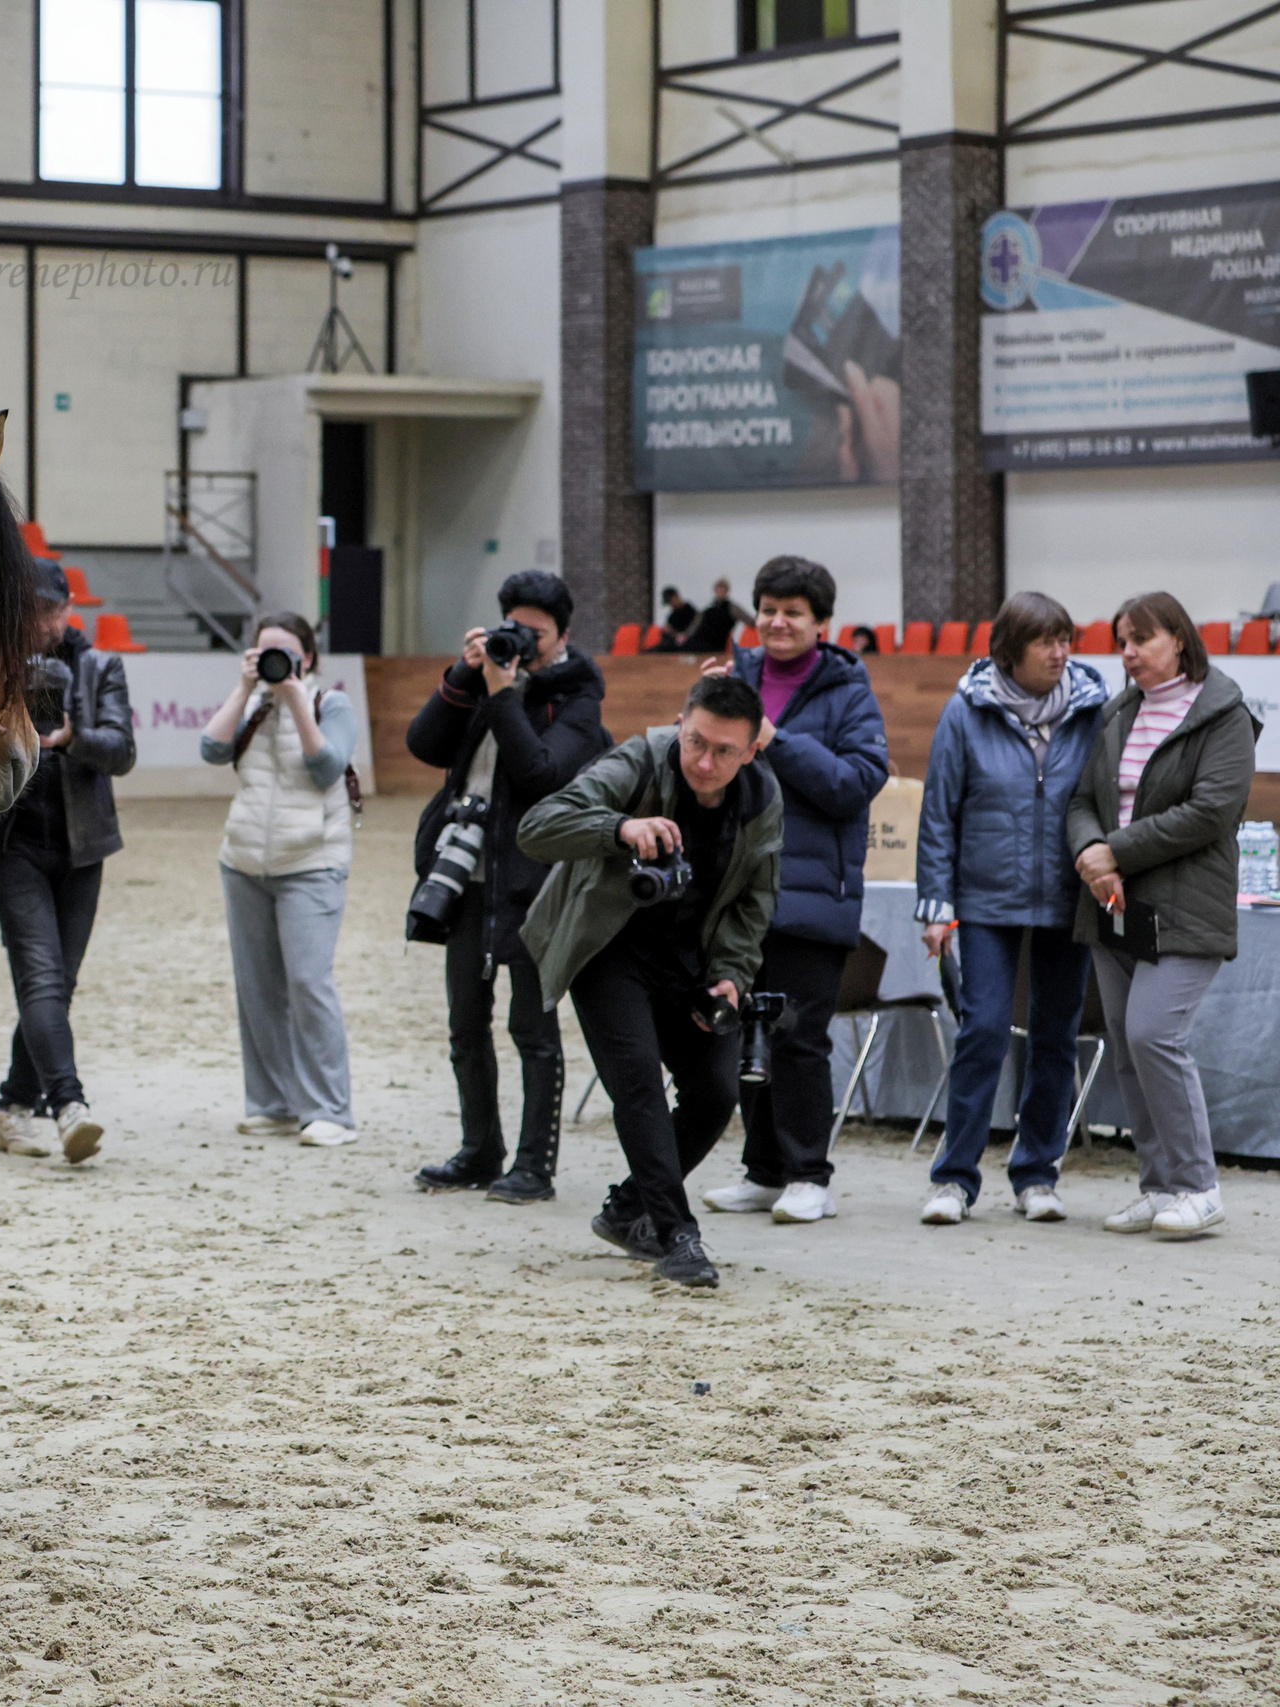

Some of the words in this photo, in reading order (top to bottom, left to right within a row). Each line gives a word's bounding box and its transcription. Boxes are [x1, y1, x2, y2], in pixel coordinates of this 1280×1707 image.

[1113, 206, 1222, 237] СПОРТИВНАЯ
[1210, 252, 1280, 281] ЛОШАД
[646, 344, 762, 376] БОНУСНАЯ
[646, 381, 778, 413] ПРОГРАММА
[645, 417, 792, 449] ЛОЯЛЬНОСТИ
